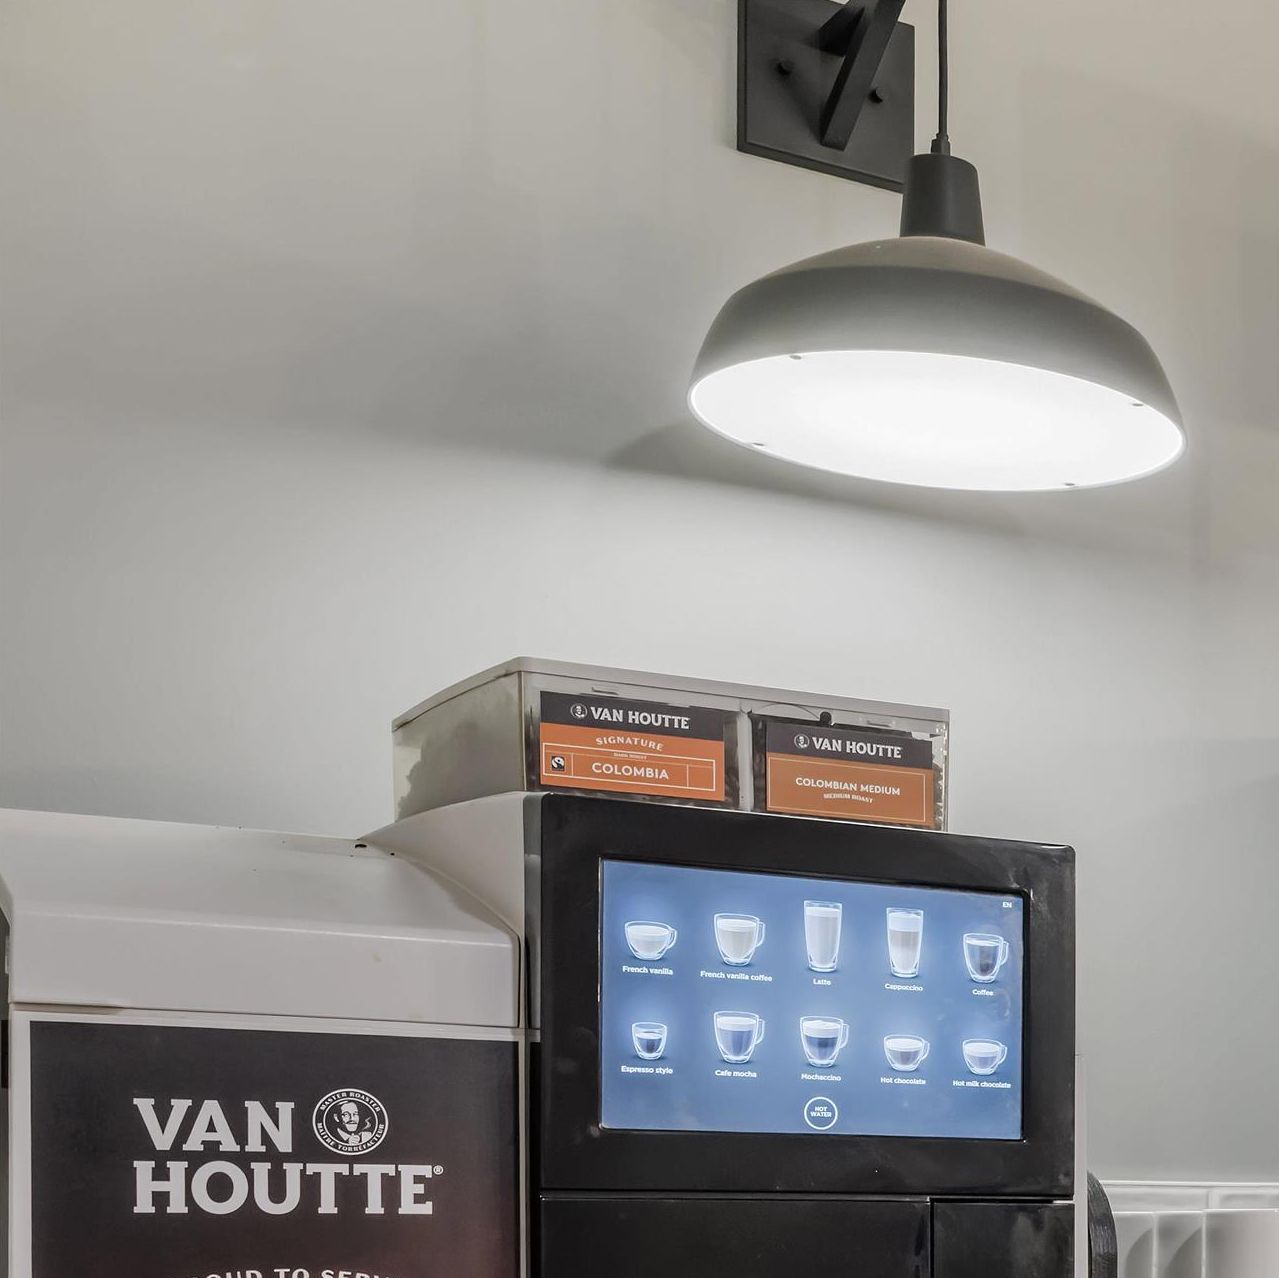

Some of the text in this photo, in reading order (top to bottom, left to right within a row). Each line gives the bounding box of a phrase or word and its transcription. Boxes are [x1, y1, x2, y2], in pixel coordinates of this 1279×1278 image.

[591, 706, 690, 730] VAN HOUTTE
[596, 735, 664, 751] SIGNATURE
[812, 736, 902, 759] VAN HOUTTE
[591, 762, 669, 780] COLOMBIA
[795, 777, 901, 796] COLOMBIAN MEDIUM
[1002, 901, 1013, 909] EN
[622, 965, 674, 976] French vanilla
[700, 970, 773, 983] French vanilla coffee
[972, 988, 994, 997] Coffee
[620, 1065, 655, 1075] Espresso
[733, 1070, 757, 1079] mocha
[320, 1091, 381, 1112] MASTER ROASTER
[814, 1105, 828, 1113] HOT
[133, 1098, 295, 1153] VAN
